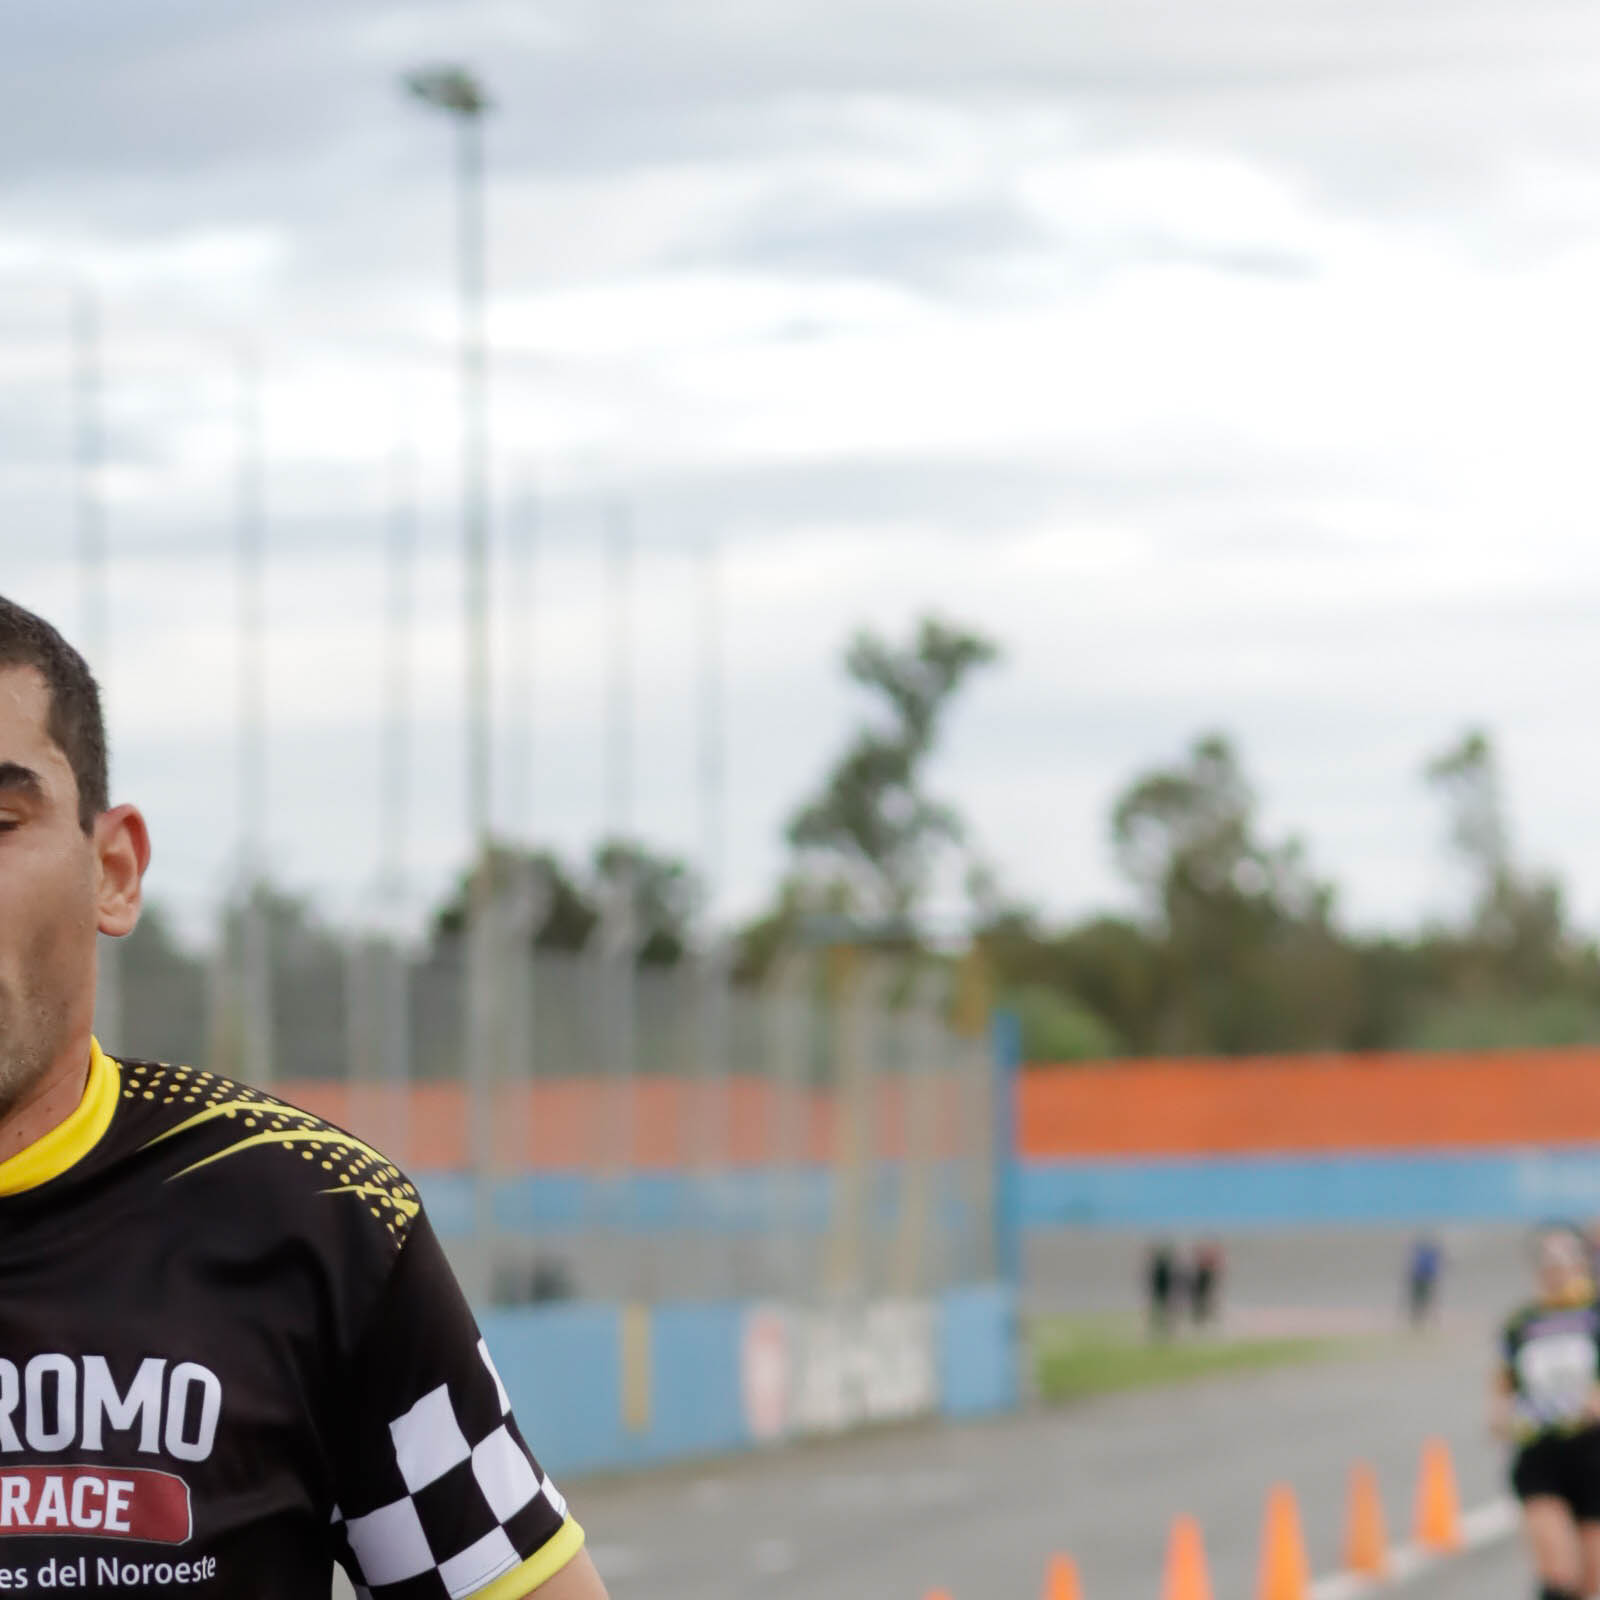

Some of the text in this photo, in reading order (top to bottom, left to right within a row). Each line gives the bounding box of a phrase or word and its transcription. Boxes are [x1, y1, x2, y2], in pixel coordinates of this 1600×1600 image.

[0, 1475, 135, 1531] RACE
[37, 1559, 87, 1588] del
[97, 1555, 216, 1586] Noroeste
